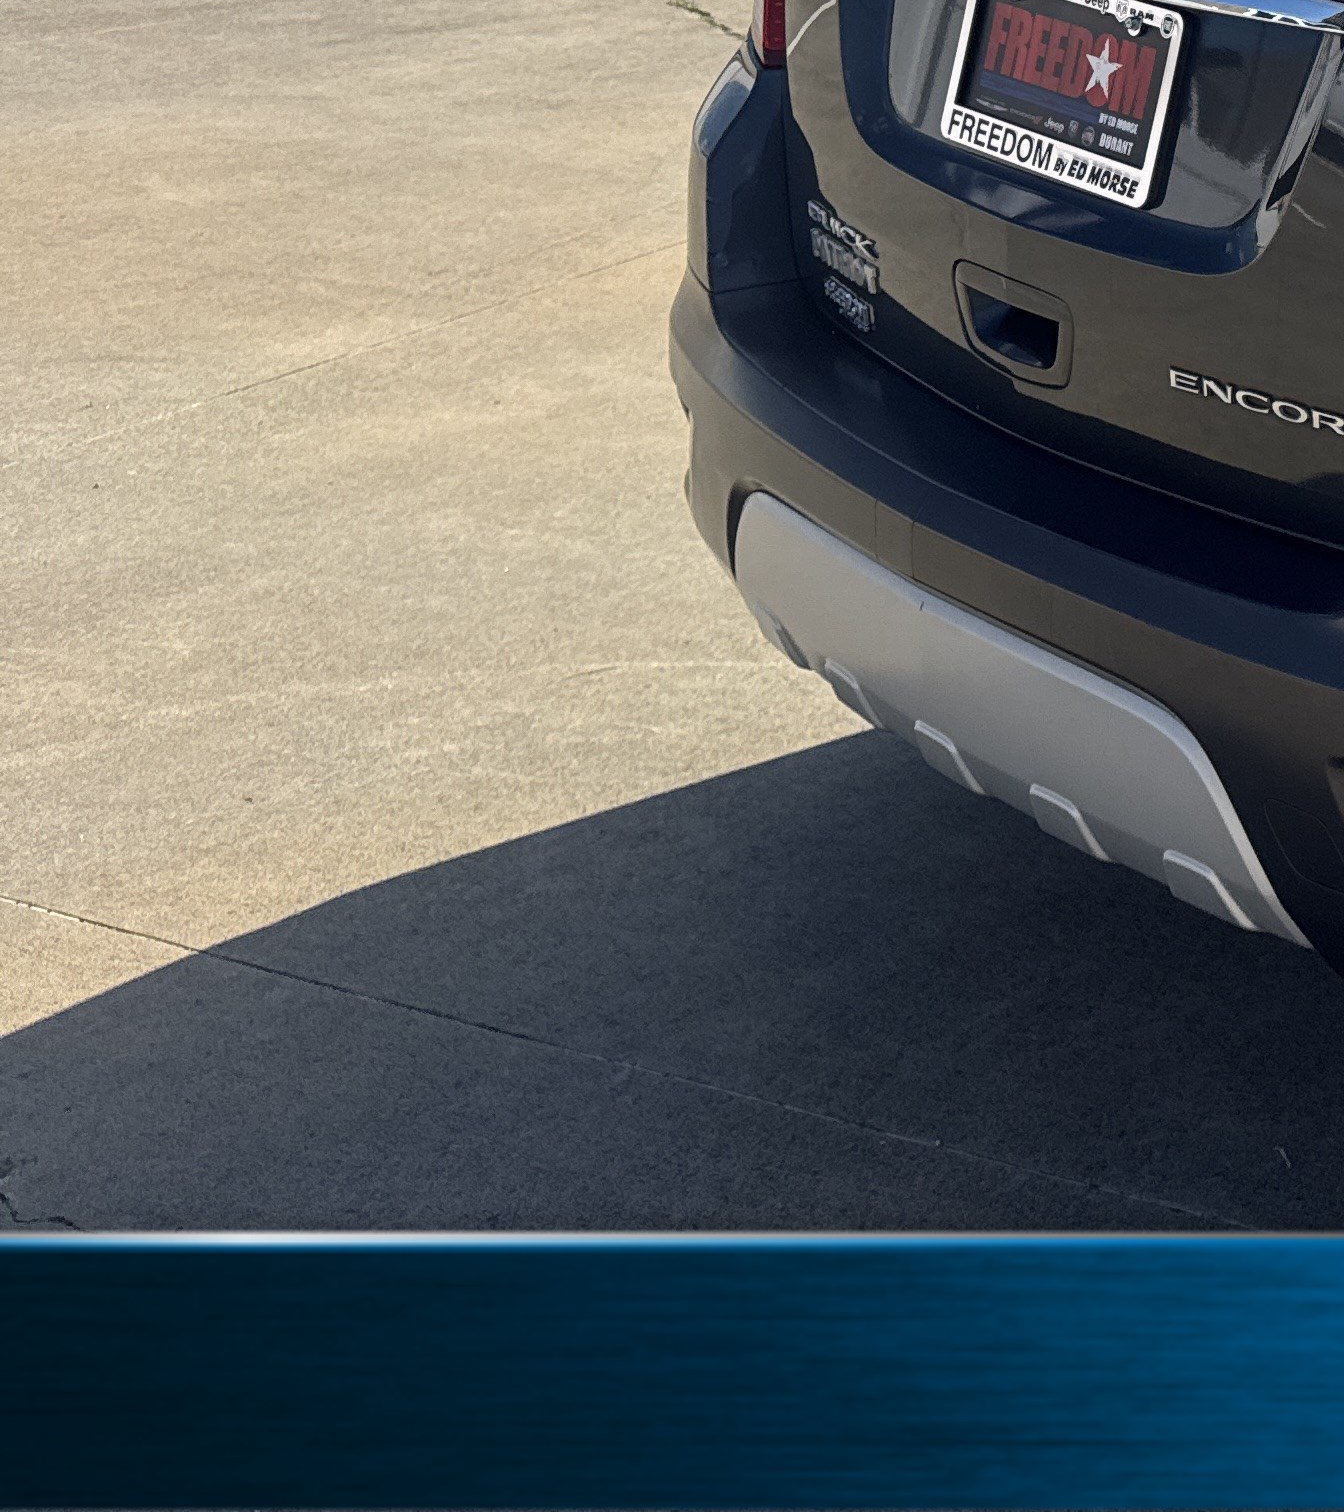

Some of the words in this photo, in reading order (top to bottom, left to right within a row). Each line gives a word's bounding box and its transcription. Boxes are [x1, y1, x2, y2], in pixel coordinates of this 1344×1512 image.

[984, 1, 1157, 120] FREEDOM
[947, 107, 1054, 171] FREEDOM
[1066, 159, 1088, 181] ED
[1086, 165, 1140, 199] MORSE
[1098, 132, 1135, 156] DURANT
